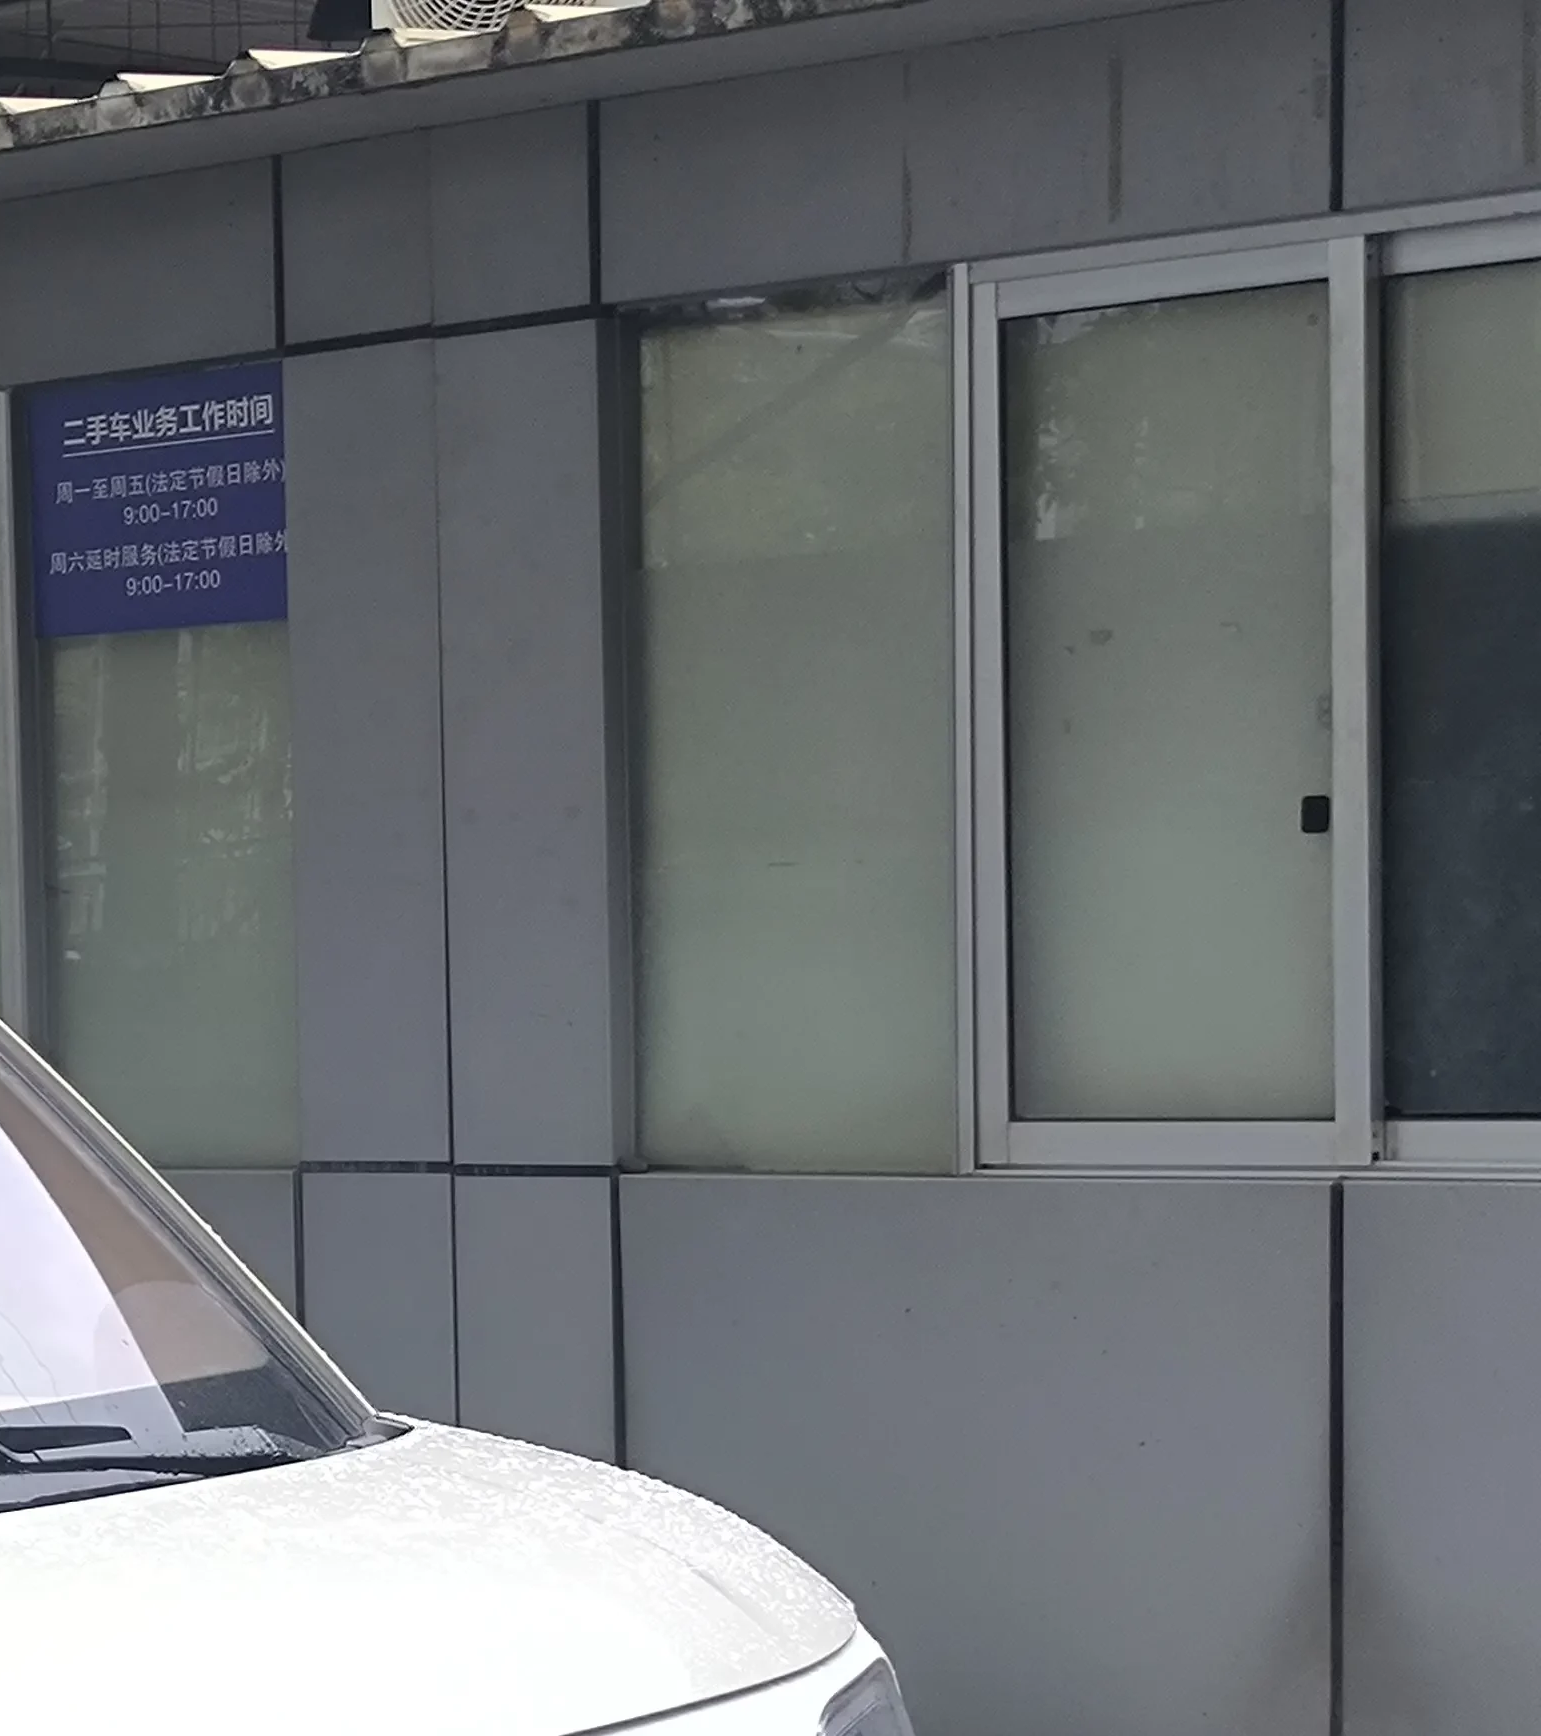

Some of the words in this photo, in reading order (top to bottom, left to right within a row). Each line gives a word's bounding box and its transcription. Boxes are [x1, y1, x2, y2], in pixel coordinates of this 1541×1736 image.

[63, 394, 274, 446] 二手车业务工作时间
[55, 458, 286, 504] 周一至周五(法定节假日除外)
